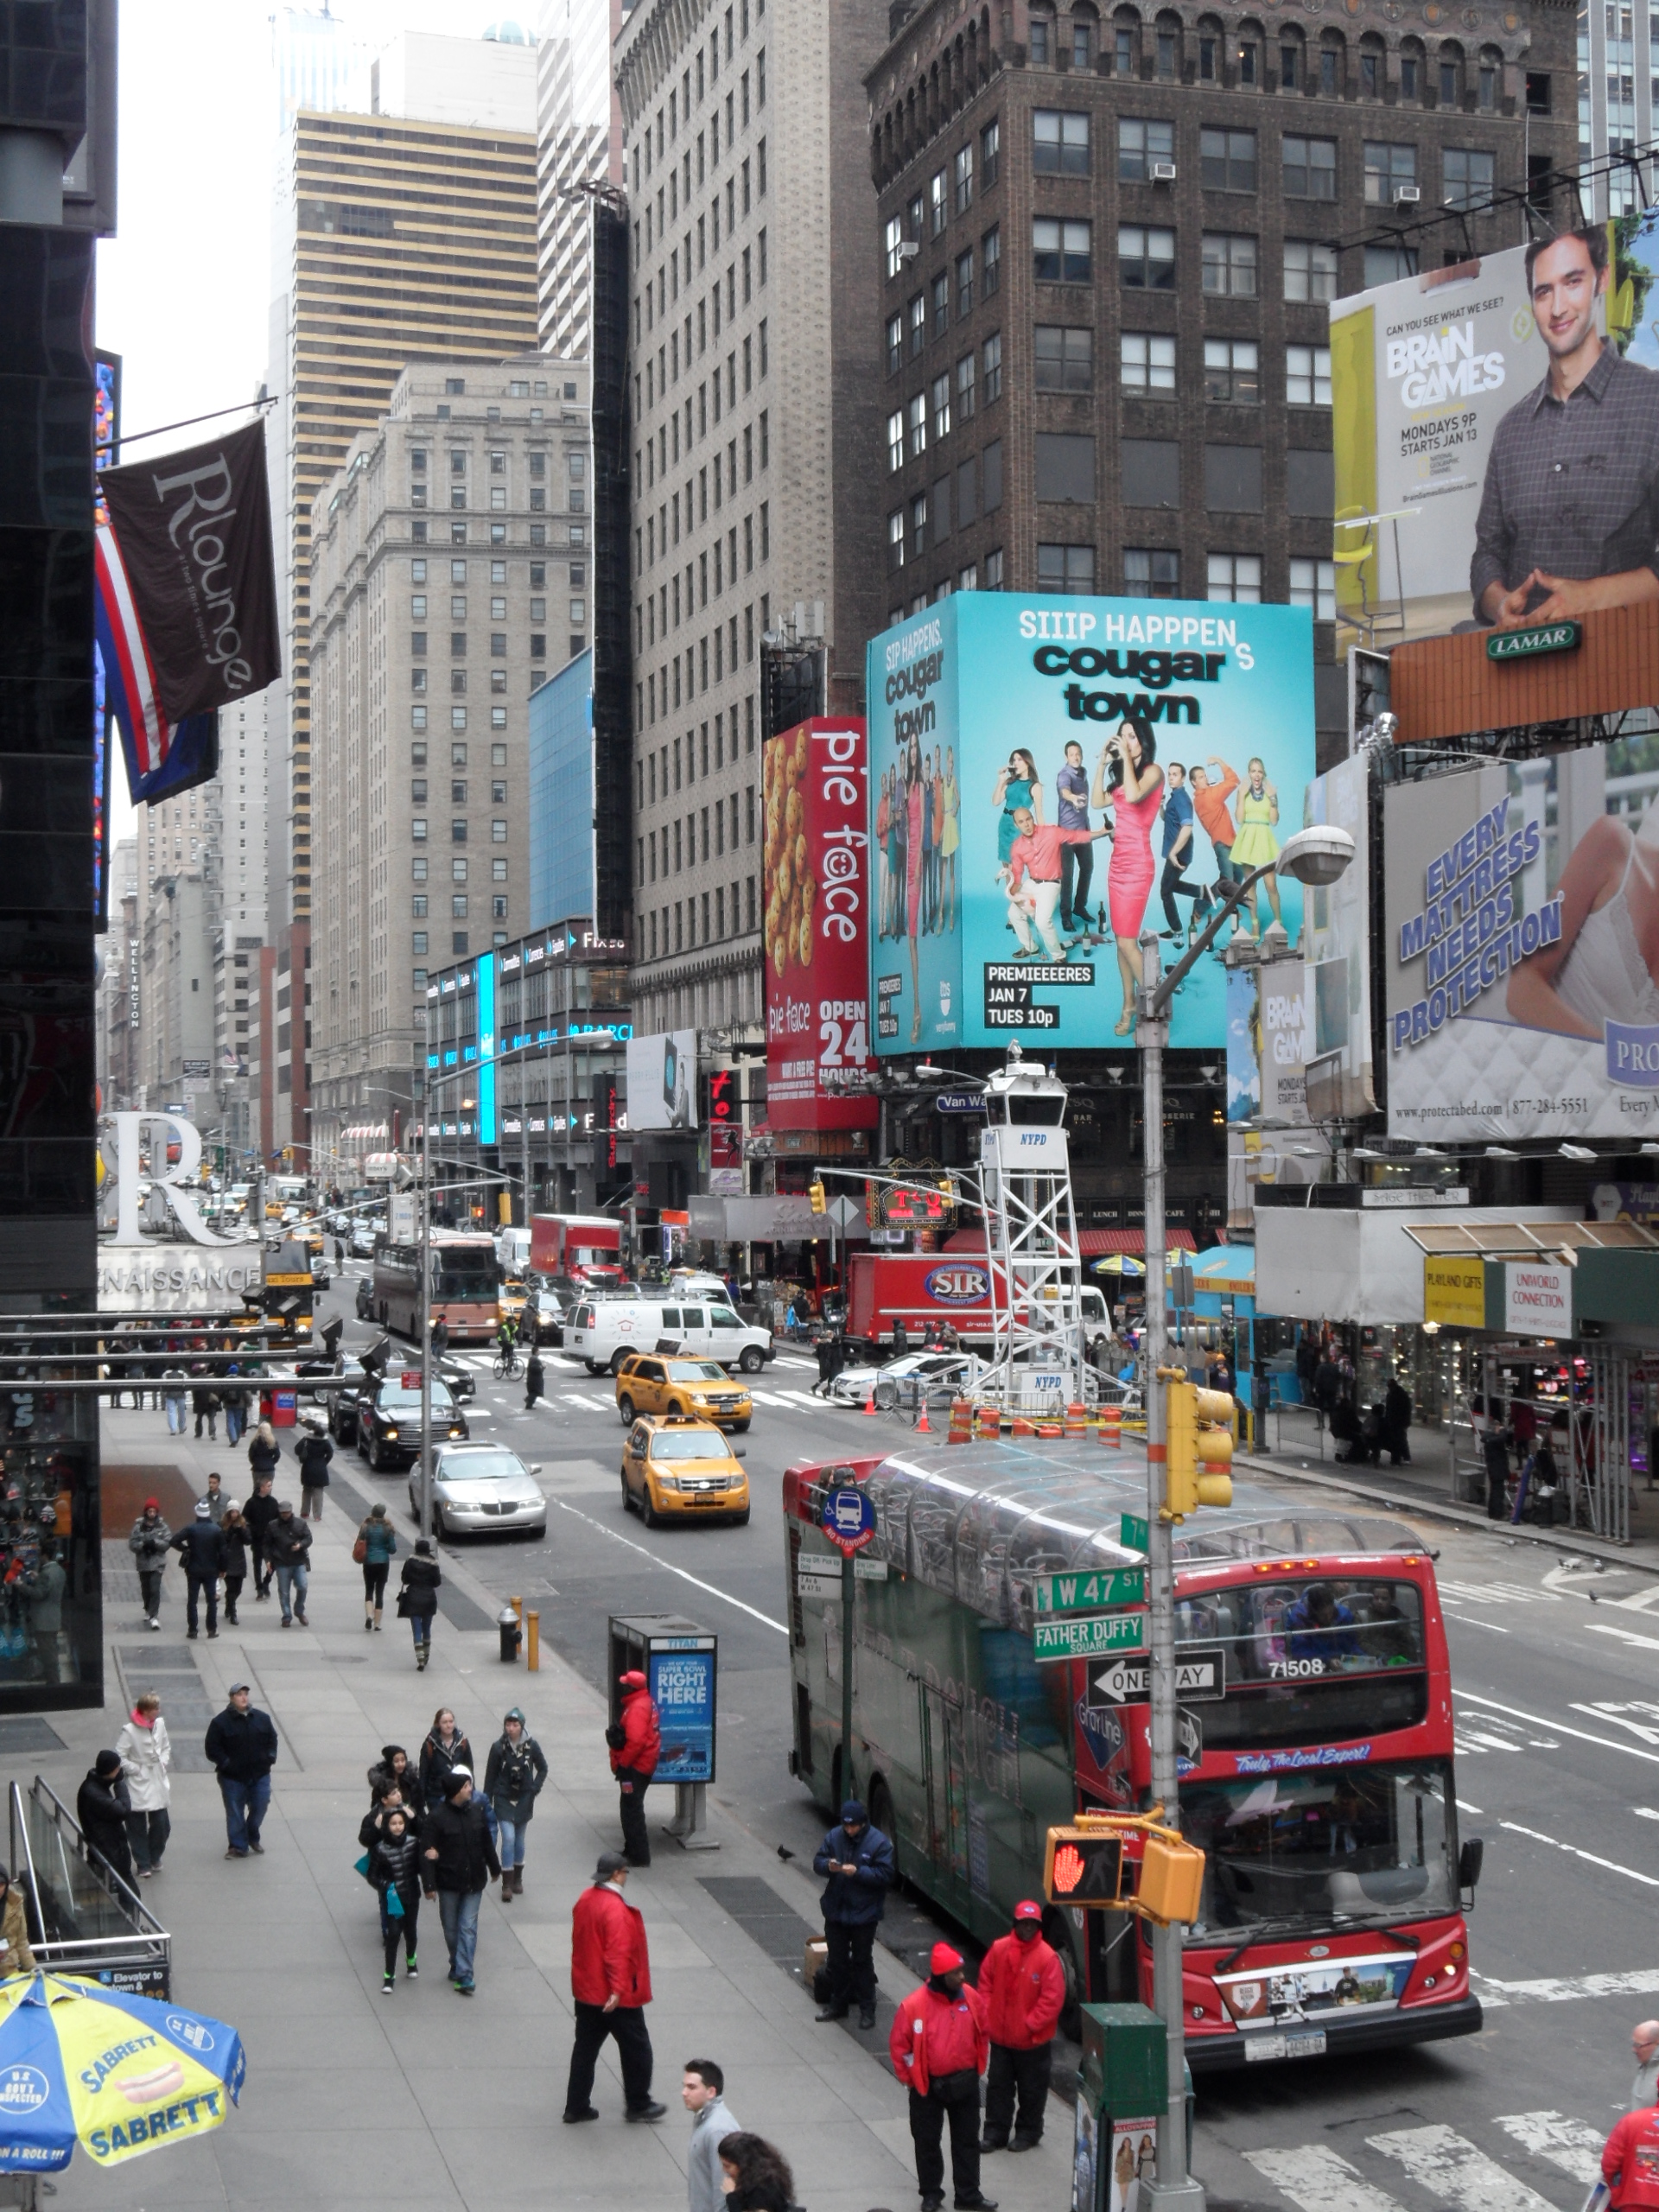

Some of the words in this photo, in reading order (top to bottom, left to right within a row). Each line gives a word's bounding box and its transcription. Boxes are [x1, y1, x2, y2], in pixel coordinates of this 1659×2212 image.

[1386, 324, 1403, 336] CAN
[1405, 320, 1421, 332] YOU
[1423, 314, 1440, 327] SEE
[1440, 307, 1466, 322] WHAT
[1467, 302, 1481, 315] WE
[1482, 296, 1504, 312] SEE?
[1401, 352, 1505, 409] GAMES
[1401, 416, 1459, 443] MONDAYS
[1461, 412, 1478, 429] 9P
[1401, 436, 1441, 457] STARTS
[1443, 431, 1464, 448] JAN
[1466, 429, 1478, 442] 13
[1497, 629, 1567, 653] LAMAR
[886, 641, 901, 672] SIP
[1033, 645, 1227, 690] cougar
[886, 649, 944, 706] cougar
[1064, 683, 1202, 725] town
[894, 700, 936, 746] town
[811, 729, 868, 805] pie
[1426, 792, 1511, 904] EVERY
[1400, 820, 1541, 963] MATTRESS
[1427, 881, 1514, 990] NEEDS
[130, 939, 140, 1028] WELLINGTON
[988, 988, 1015, 1002] JAN
[1018, 988, 1028, 1002] 7
[769, 993, 785, 1044] pie
[819, 1001, 866, 1021] OPEN
[988, 1008, 1025, 1025] TUES
[1027, 1008, 1054, 1028] 10p
[820, 1020, 869, 1066] 24
[944, 1096, 966, 1108] Van
[1395, 1100, 1503, 1123] www.protectabed.com
[1513, 1096, 1588, 1116] 877-284-5551
[1619, 1095, 1651, 1118] Every
[1020, 1134, 1047, 1146] NYPD
[103, 1111, 257, 1247] R
[98, 1266, 260, 1292] NAISSANCE
[935, 1273, 987, 1294] SIR
[1427, 1273, 1462, 1288] PLAYLAND
[1463, 1275, 1483, 1290] GIFTS
[1516, 1273, 1560, 1290] UNIWORLD
[1512, 1290, 1565, 1309] CONNECTION
[1034, 1376, 1062, 1389] NYPD
[826, 1527, 836, 1540] NO
[835, 1531, 870, 1548] STANDING
[1059, 1579, 1077, 1606] W
[1084, 1574, 1116, 1603] 47
[1123, 1572, 1140, 1587] ST
[667, 1638, 699, 1649] TITAN
[1036, 1623, 1089, 1648] FATHER
[1093, 1618, 1140, 1642] DUFFY
[1070, 1639, 1109, 1654] SQUARE
[658, 1665, 682, 1674] SUPER
[683, 1665, 707, 1674] BOWL
[1112, 1670, 1151, 1691] ONE
[1175, 1667, 1205, 1686] AY
[1268, 1658, 1324, 1678] 71508
[658, 1673, 707, 1688] RIGHT
[657, 1686, 707, 1705] HERE
[1291, 1747, 1323, 1768] Local
[1119, 1829, 1141, 1841] TIME
[113, 1972, 151, 1983] Elevator
[153, 1970, 163, 1980] to
[80, 2034, 158, 2094] SABRETT
[0, 2092, 42, 2104] NSPECTED
[90, 2088, 220, 2158] SABRETT
[11, 2147, 19, 2158] A
[22, 2147, 48, 2160] ROLL
